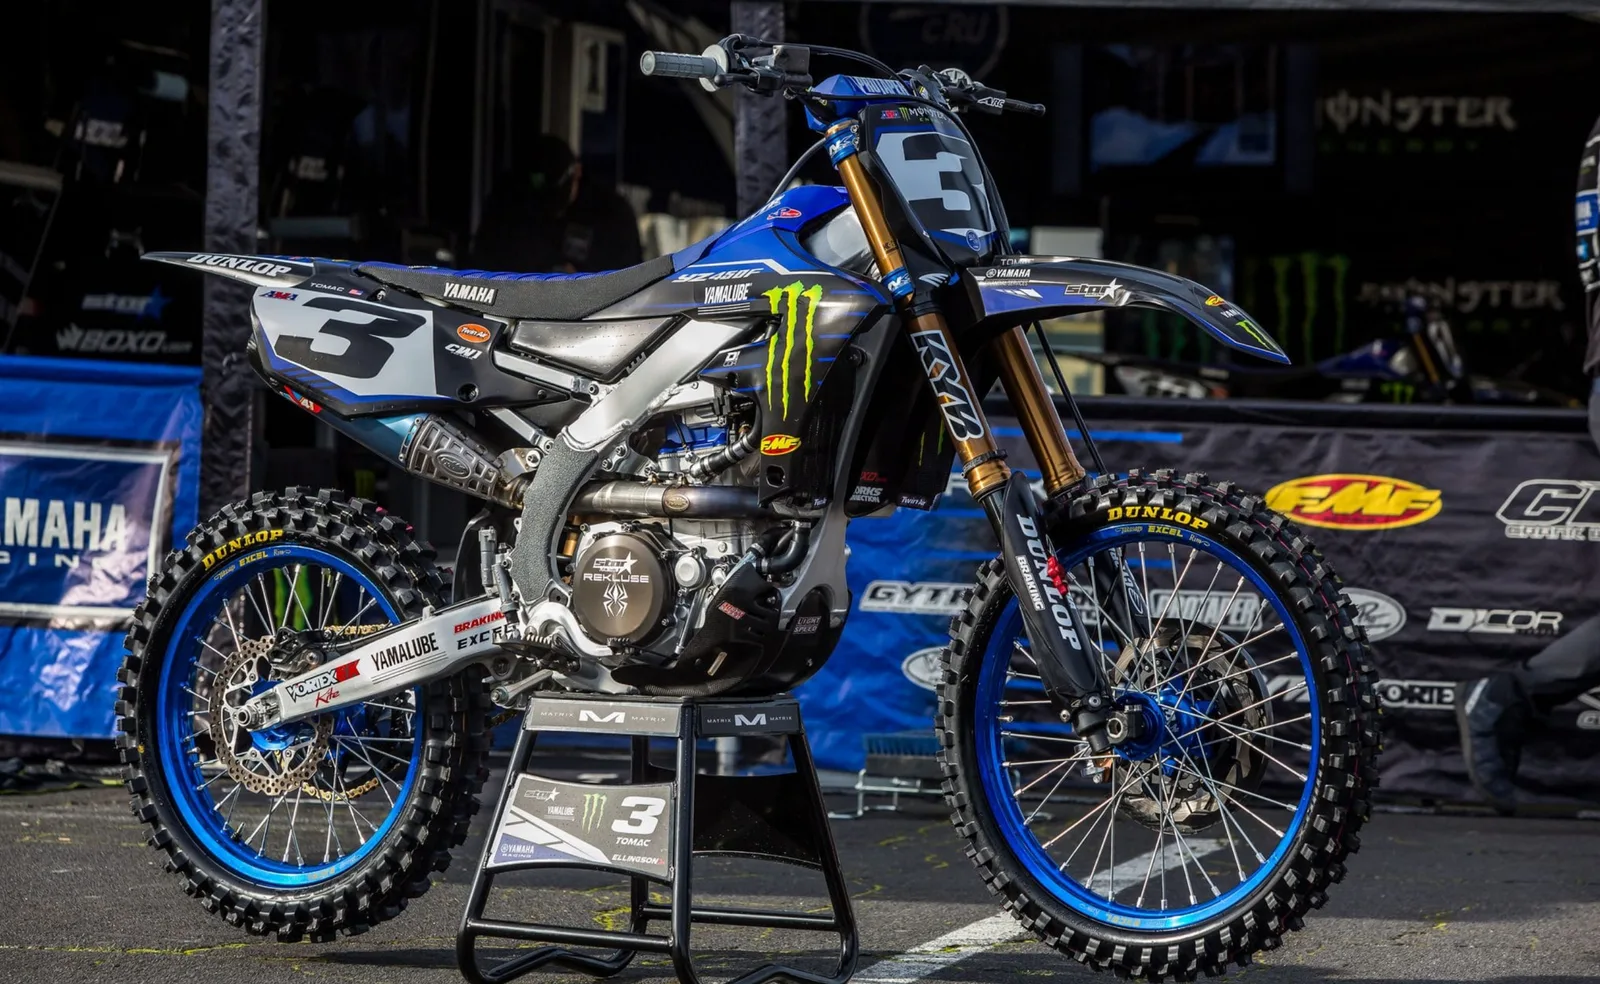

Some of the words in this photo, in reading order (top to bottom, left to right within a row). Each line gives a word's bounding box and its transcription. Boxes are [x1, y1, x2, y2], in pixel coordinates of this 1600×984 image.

[902, 133, 990, 232] 3
[187, 254, 292, 277] DUNLOP
[996, 268, 1031, 278] YAMAHA
[259, 290, 299, 301] AMA
[310, 282, 345, 292] TOMAC
[443, 282, 496, 304] YAMAHA
[703, 282, 752, 305] YAMALUBE
[274, 296, 427, 379] 3
[910, 329, 984, 442] KYB
[760, 436, 801, 451] FMF
[1268, 481, 1442, 516] FMF
[0, 497, 126, 551] MAHA
[1107, 505, 1209, 530] DUNLOP
[1147, 525, 1183, 538] EXCEL
[202, 529, 284, 571] DUNLOP
[239, 551, 268, 567] EXCEL
[583, 573, 650, 584] REKLUSE
[1017, 555, 1044, 611] BRAKING
[370, 632, 440, 672] YAMALUBE
[286, 667, 339, 704] VORTEX
[631, 715, 667, 723] MATRIX
[546, 805, 576, 817] YAMALUBE
[611, 796, 666, 835] 3
[508, 843, 535, 854] YAMAHA
[615, 836, 652, 847] TOMAC
[611, 853, 659, 865] ELLINGSON
